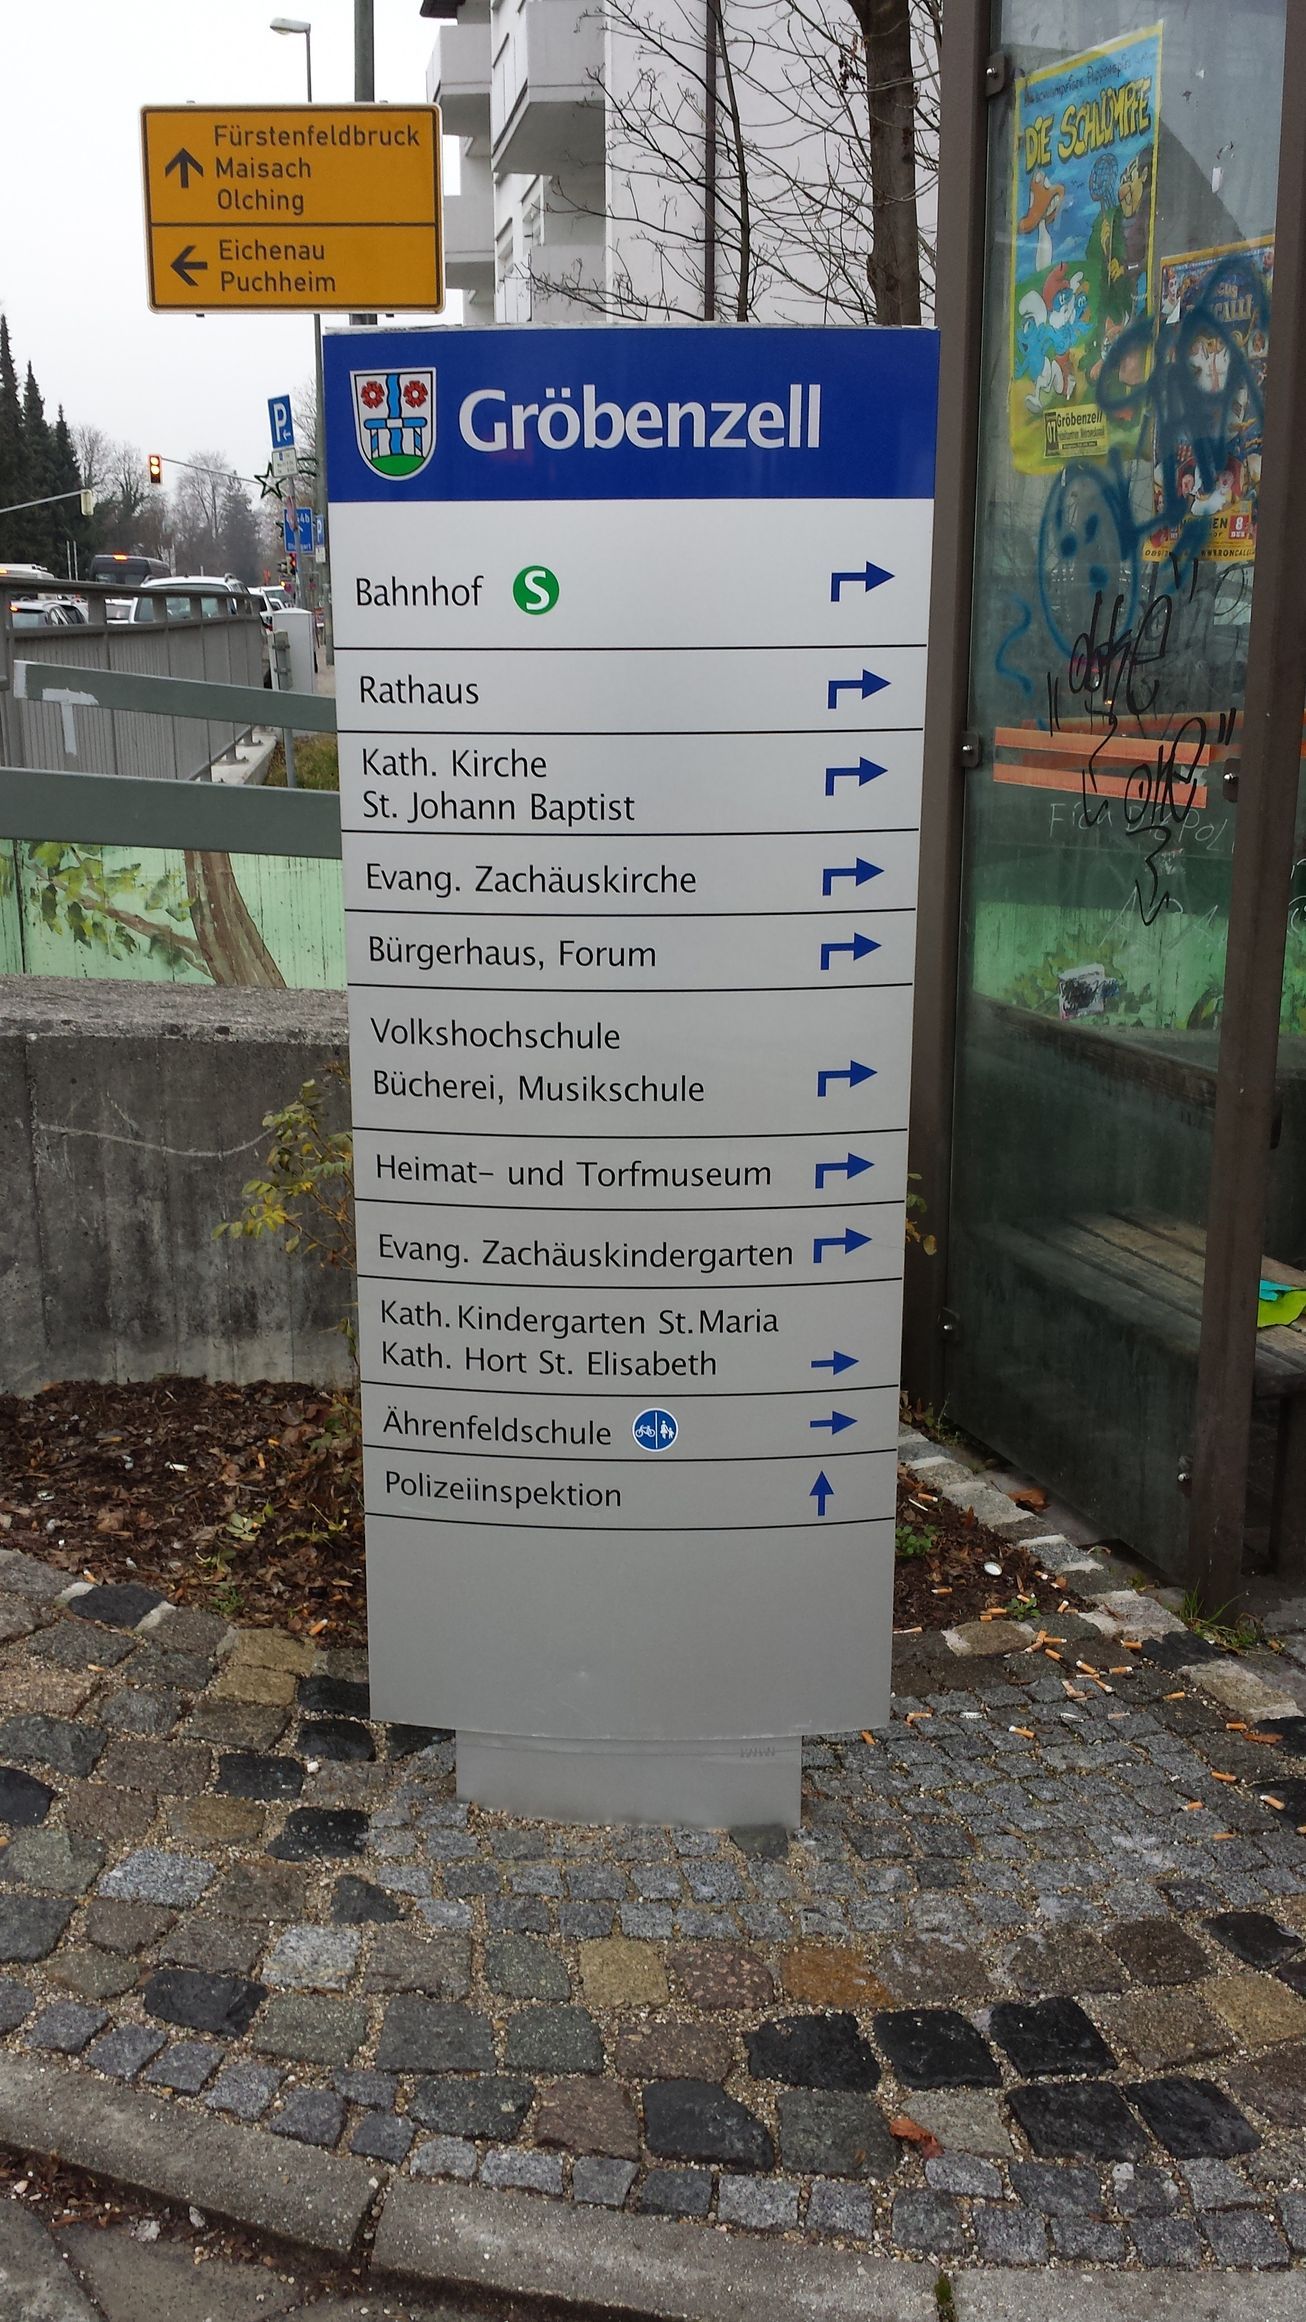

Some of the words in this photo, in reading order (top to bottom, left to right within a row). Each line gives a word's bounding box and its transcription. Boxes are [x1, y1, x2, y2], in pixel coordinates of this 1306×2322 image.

[213, 124, 421, 147] Fürstenfeldbruck
[1058, 75, 1153, 164] SCHLÜMPFE
[215, 157, 312, 179] Maisach
[217, 188, 305, 216] Olching
[218, 239, 325, 261] Eichenau
[220, 271, 336, 292] Puchheim
[274, 402, 287, 442] P
[458, 383, 821, 453] Gröbenzell
[1057, 410, 1103, 428] Gröbenzell
[1235, 516, 1244, 531] 8
[355, 574, 485, 607] Bahnhof
[359, 673, 480, 705] Rathaus
[362, 746, 437, 777] Kath.
[452, 747, 547, 778] Kirche
[363, 789, 398, 819] St.
[406, 790, 516, 824] Johann
[530, 792, 636, 828] Baptist
[366, 862, 461, 899] Evang.
[474, 864, 697, 894] Zachäuskirche
[369, 935, 544, 971] Bürgerhaus,
[559, 939, 656, 967] Forum
[369, 1017, 620, 1050] Volkshochschule
[373, 1069, 504, 1105] Bücherei,
[519, 1074, 705, 1103] Musikschule
[376, 1153, 495, 1184] Heimat-
[508, 1159, 564, 1187] und
[575, 1160, 771, 1188] Torfmuseum
[379, 1233, 469, 1269] Evang.
[482, 1239, 793, 1274] Zachäuskindergarten
[382, 1340, 451, 1370] Kath.
[465, 1346, 528, 1374] Hort
[539, 1349, 573, 1375] St.
[588, 1349, 717, 1377] Elisabeth
[382, 1405, 612, 1446] Ährenfeldschule
[385, 1470, 621, 1510] Polizeiinspektion
